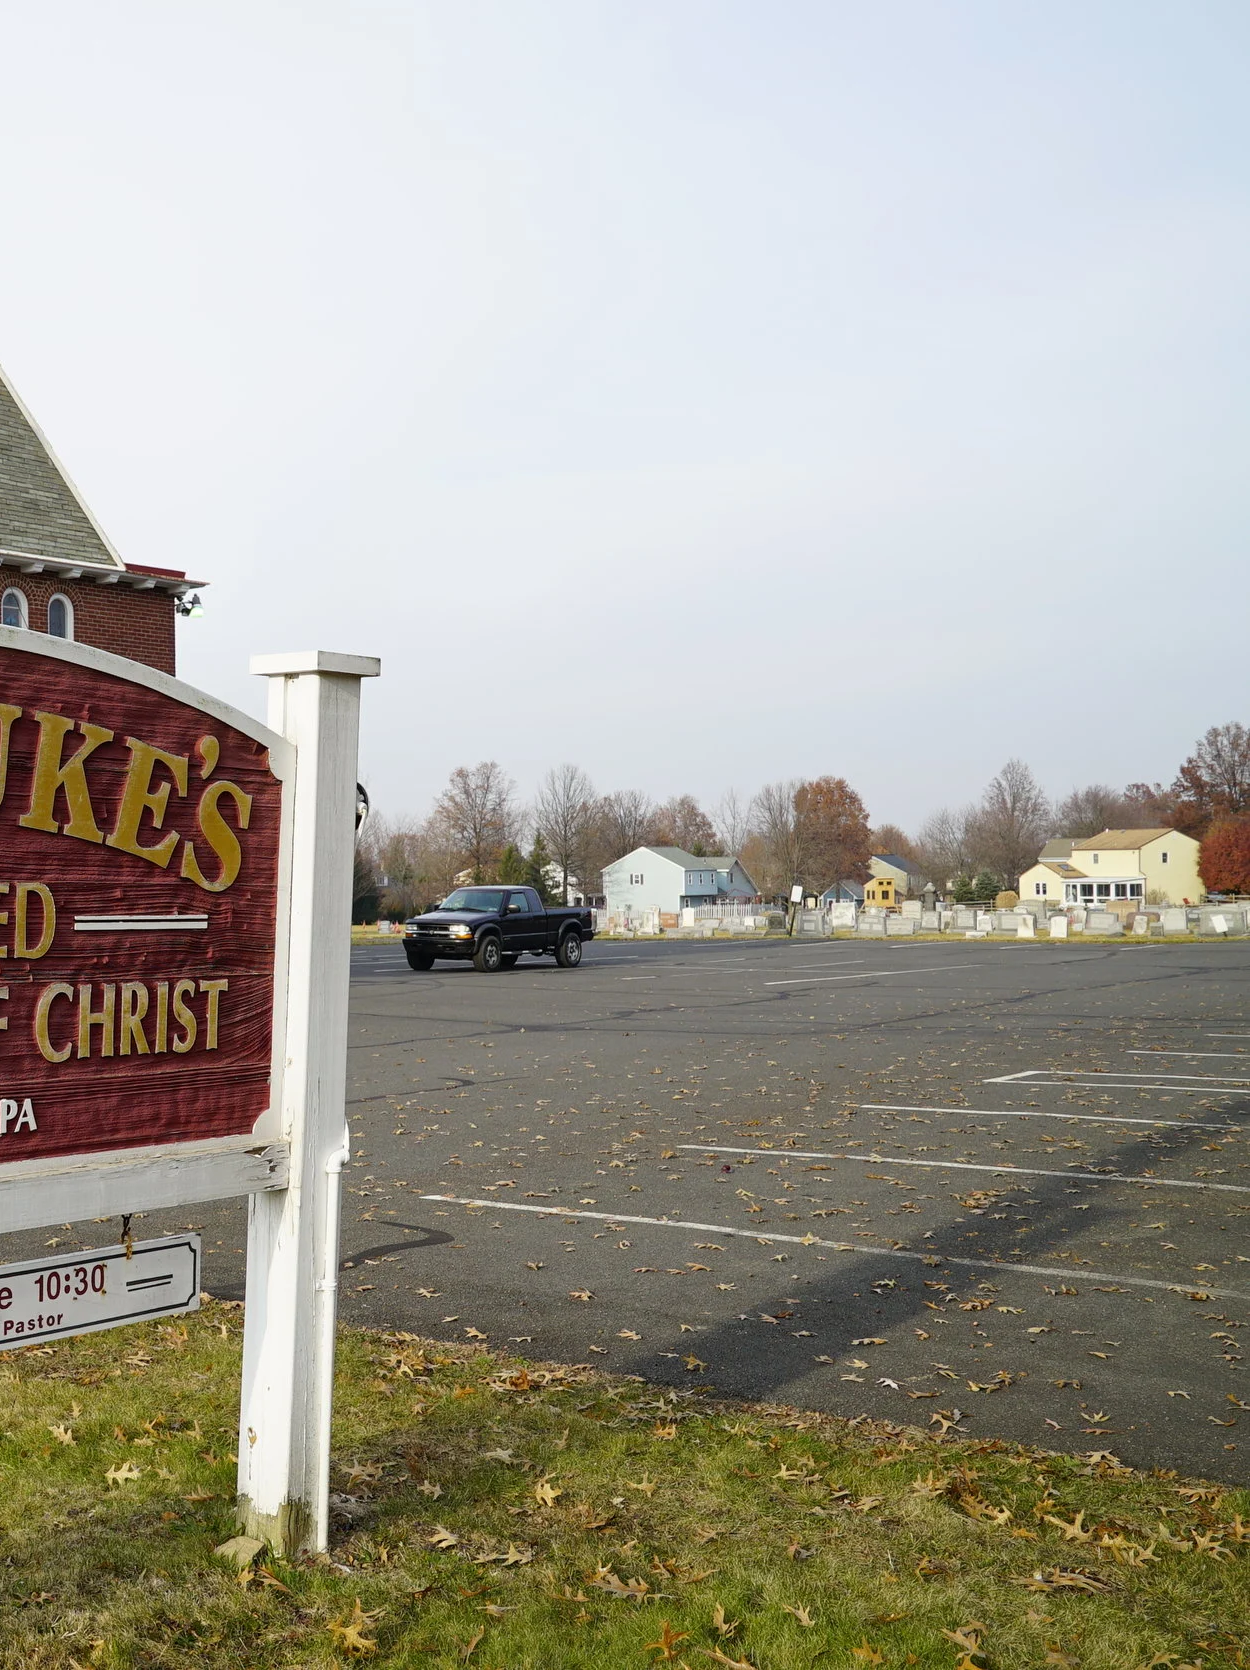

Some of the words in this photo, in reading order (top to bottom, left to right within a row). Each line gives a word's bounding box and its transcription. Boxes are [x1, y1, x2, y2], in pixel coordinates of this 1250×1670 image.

[35, 979, 228, 1063] CHRIST
[0, 1098, 37, 1136] PA
[34, 1264, 105, 1302] 10:30
[3, 1313, 63, 1336] Pastor
